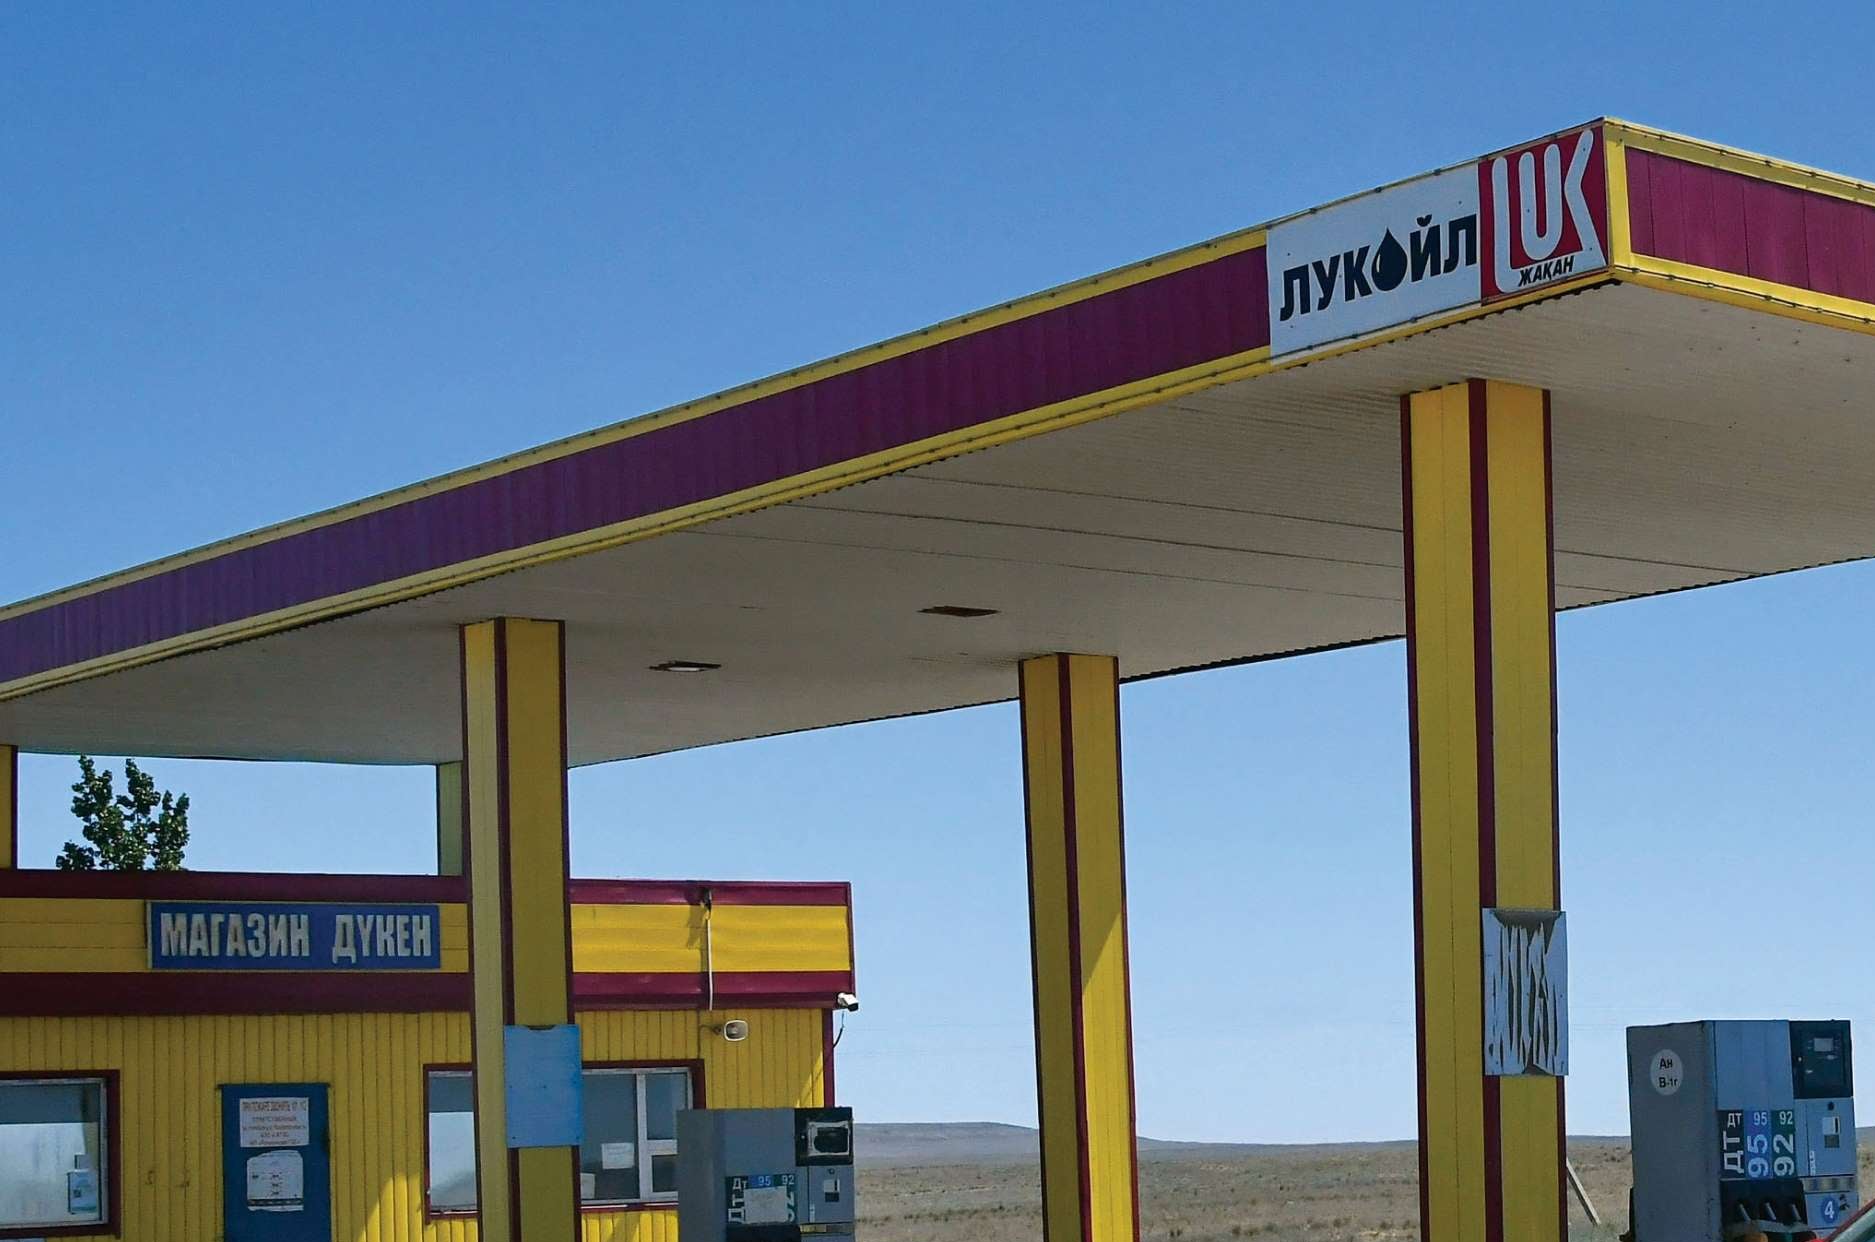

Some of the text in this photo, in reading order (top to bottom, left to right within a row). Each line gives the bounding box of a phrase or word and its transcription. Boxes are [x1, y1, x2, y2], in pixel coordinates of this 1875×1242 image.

[160, 912, 310, 958] МАГАЗИН
[1727, 1111, 1793, 1128] ДТ 95 92
[1722, 1130, 1745, 1174] ДТ
[1747, 1134, 1769, 1178] 95
[1773, 1133, 1795, 1177] 92
[758, 1175, 771, 1186] 95
[782, 1174, 795, 1185] 92
[1824, 1200, 1835, 1219] 4
